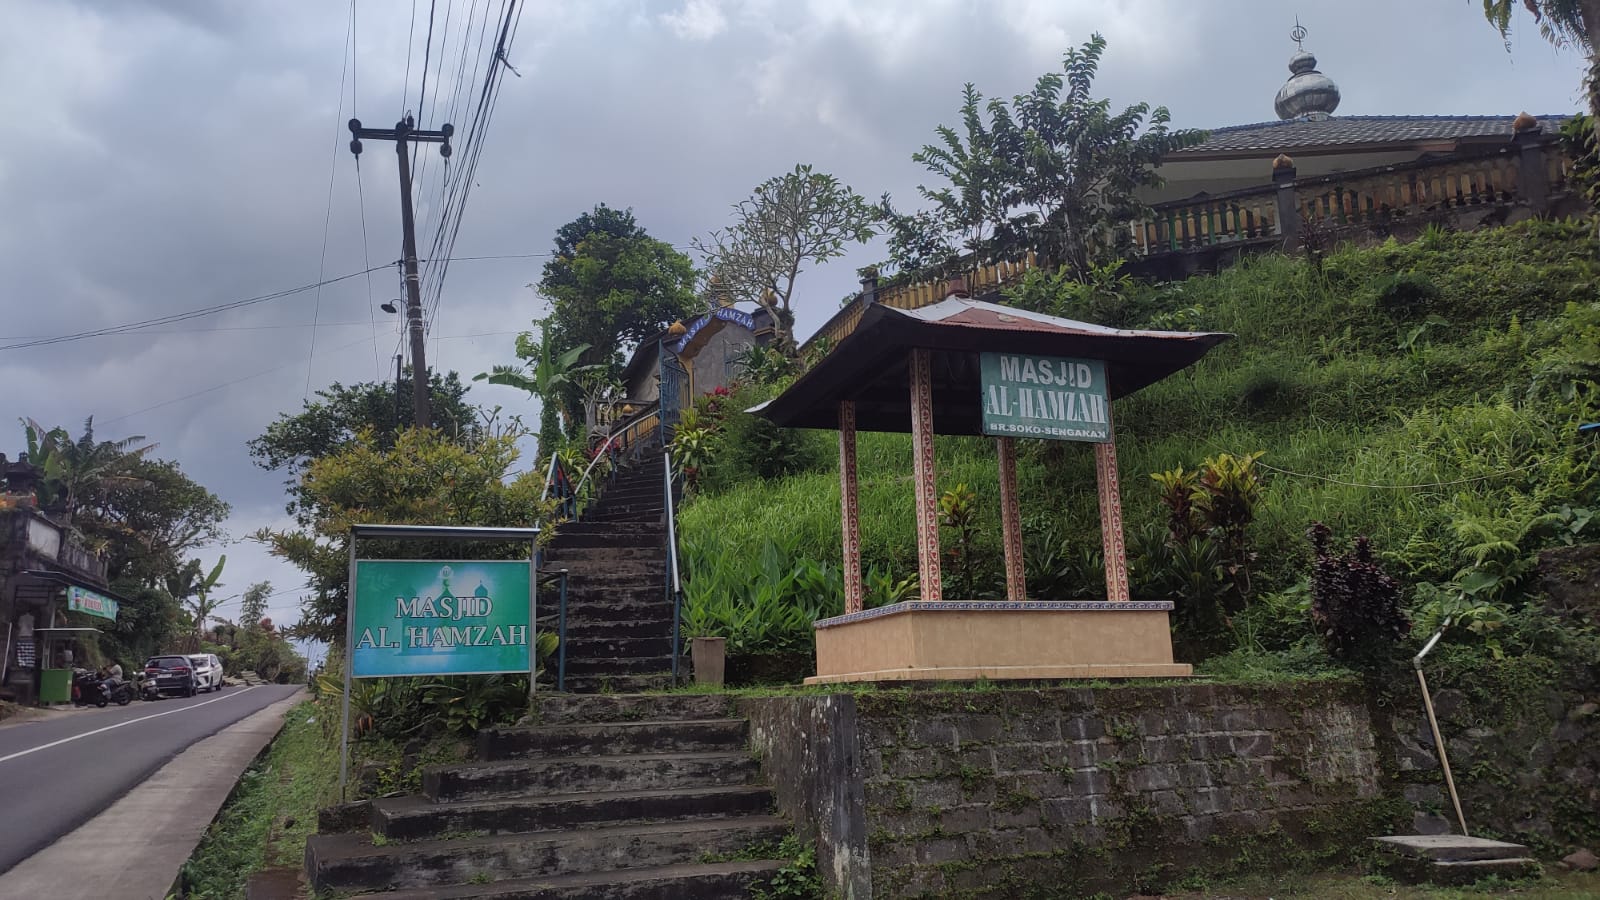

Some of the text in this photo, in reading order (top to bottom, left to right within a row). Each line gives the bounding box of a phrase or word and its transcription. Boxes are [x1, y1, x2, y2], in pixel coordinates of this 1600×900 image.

[716, 310, 754, 328] HAMZAH
[1000, 355, 1092, 389] MASJID
[986, 384, 1107, 424] AL-HAMZAH
[395, 596, 494, 622] MASJID
[356, 624, 528, 649] AL. HAMZAH
